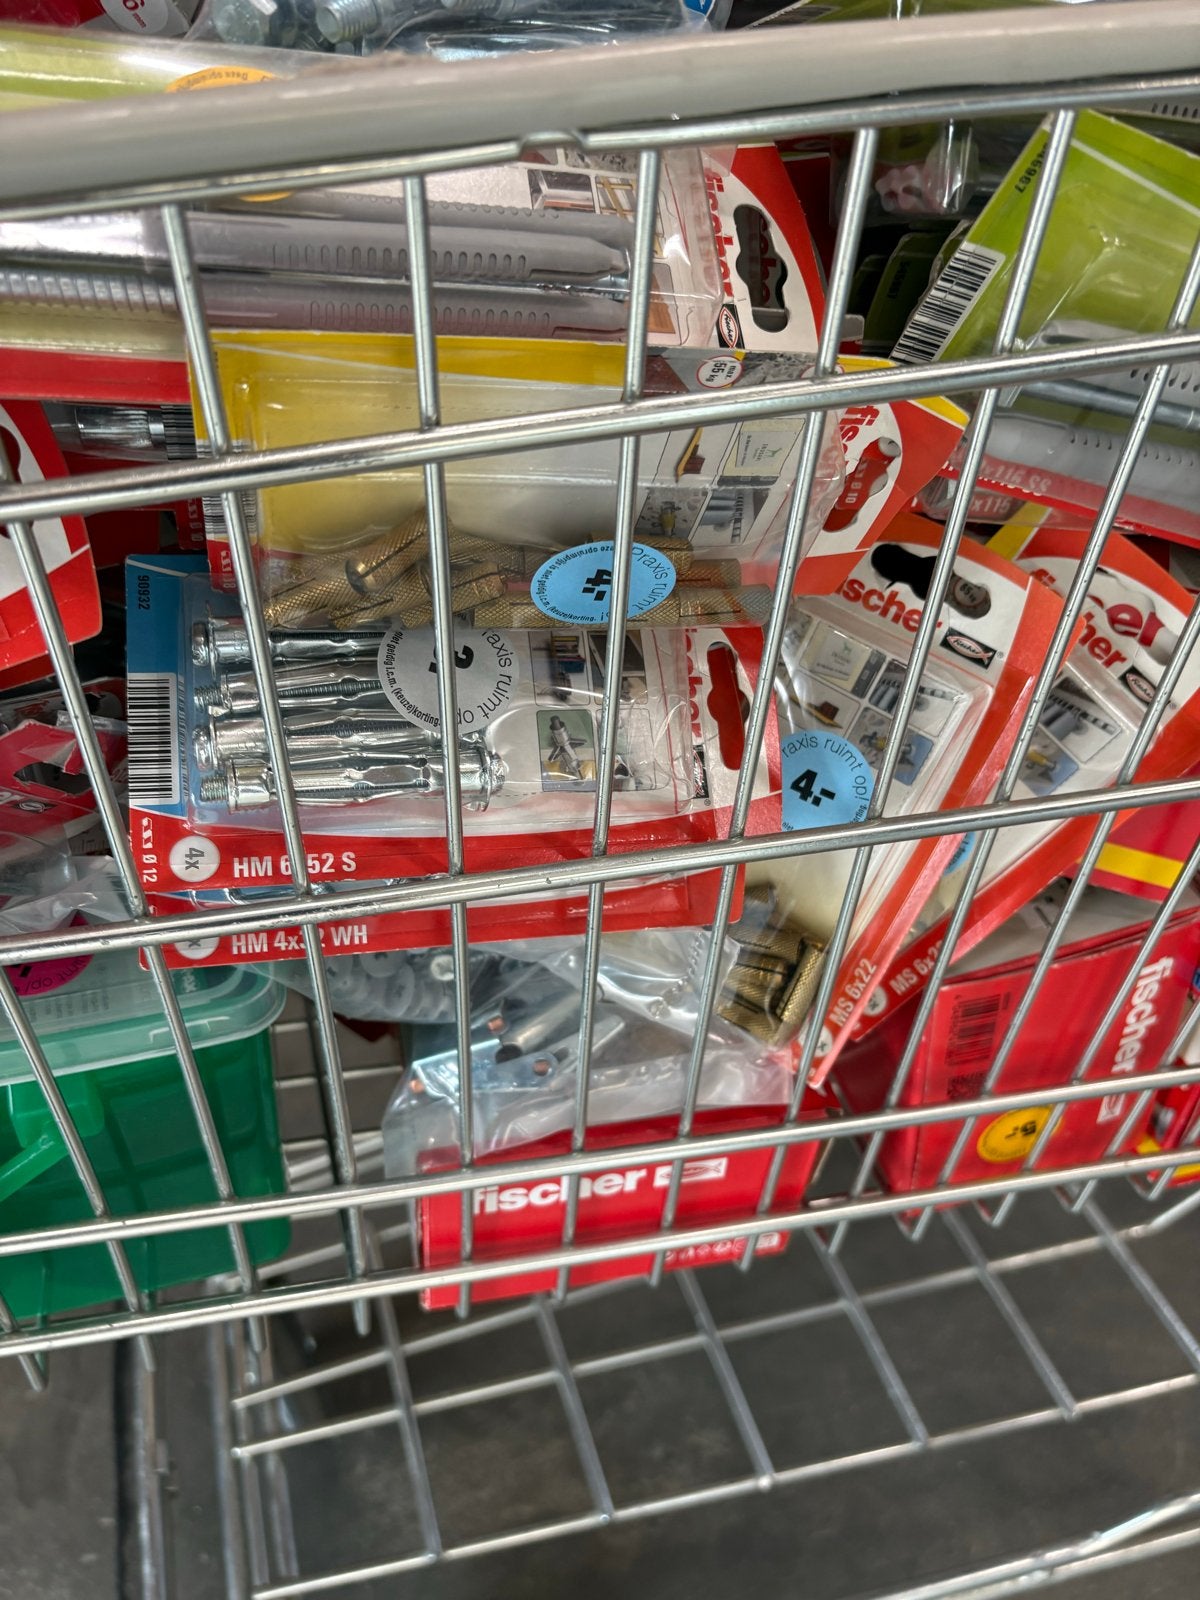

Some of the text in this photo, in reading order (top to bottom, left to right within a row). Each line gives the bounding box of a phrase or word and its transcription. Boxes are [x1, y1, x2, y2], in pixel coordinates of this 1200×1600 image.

[138, 575, 150, 610] 90932
[632, 583, 667, 611] ruimt
[834, 577, 943, 633] sche
[482, 631, 513, 668] axis
[383, 643, 396, 666] geldig
[391, 687, 441, 728] (keuze)korting.
[477, 674, 513, 720] ruimt
[781, 733, 870, 802] raxis ruimt op!
[790, 768, 836, 808] 4.-
[142, 868, 158, 883] 12
[184, 847, 205, 871] 4x
[233, 851, 358, 879] HM 652 S
[232, 924, 368, 955] HM 4x WH
[829, 958, 878, 1027] MS 6x22
[889, 967, 918, 996] MS
[1111, 955, 1174, 1074] fischer
[472, 1168, 648, 1216] fischer
